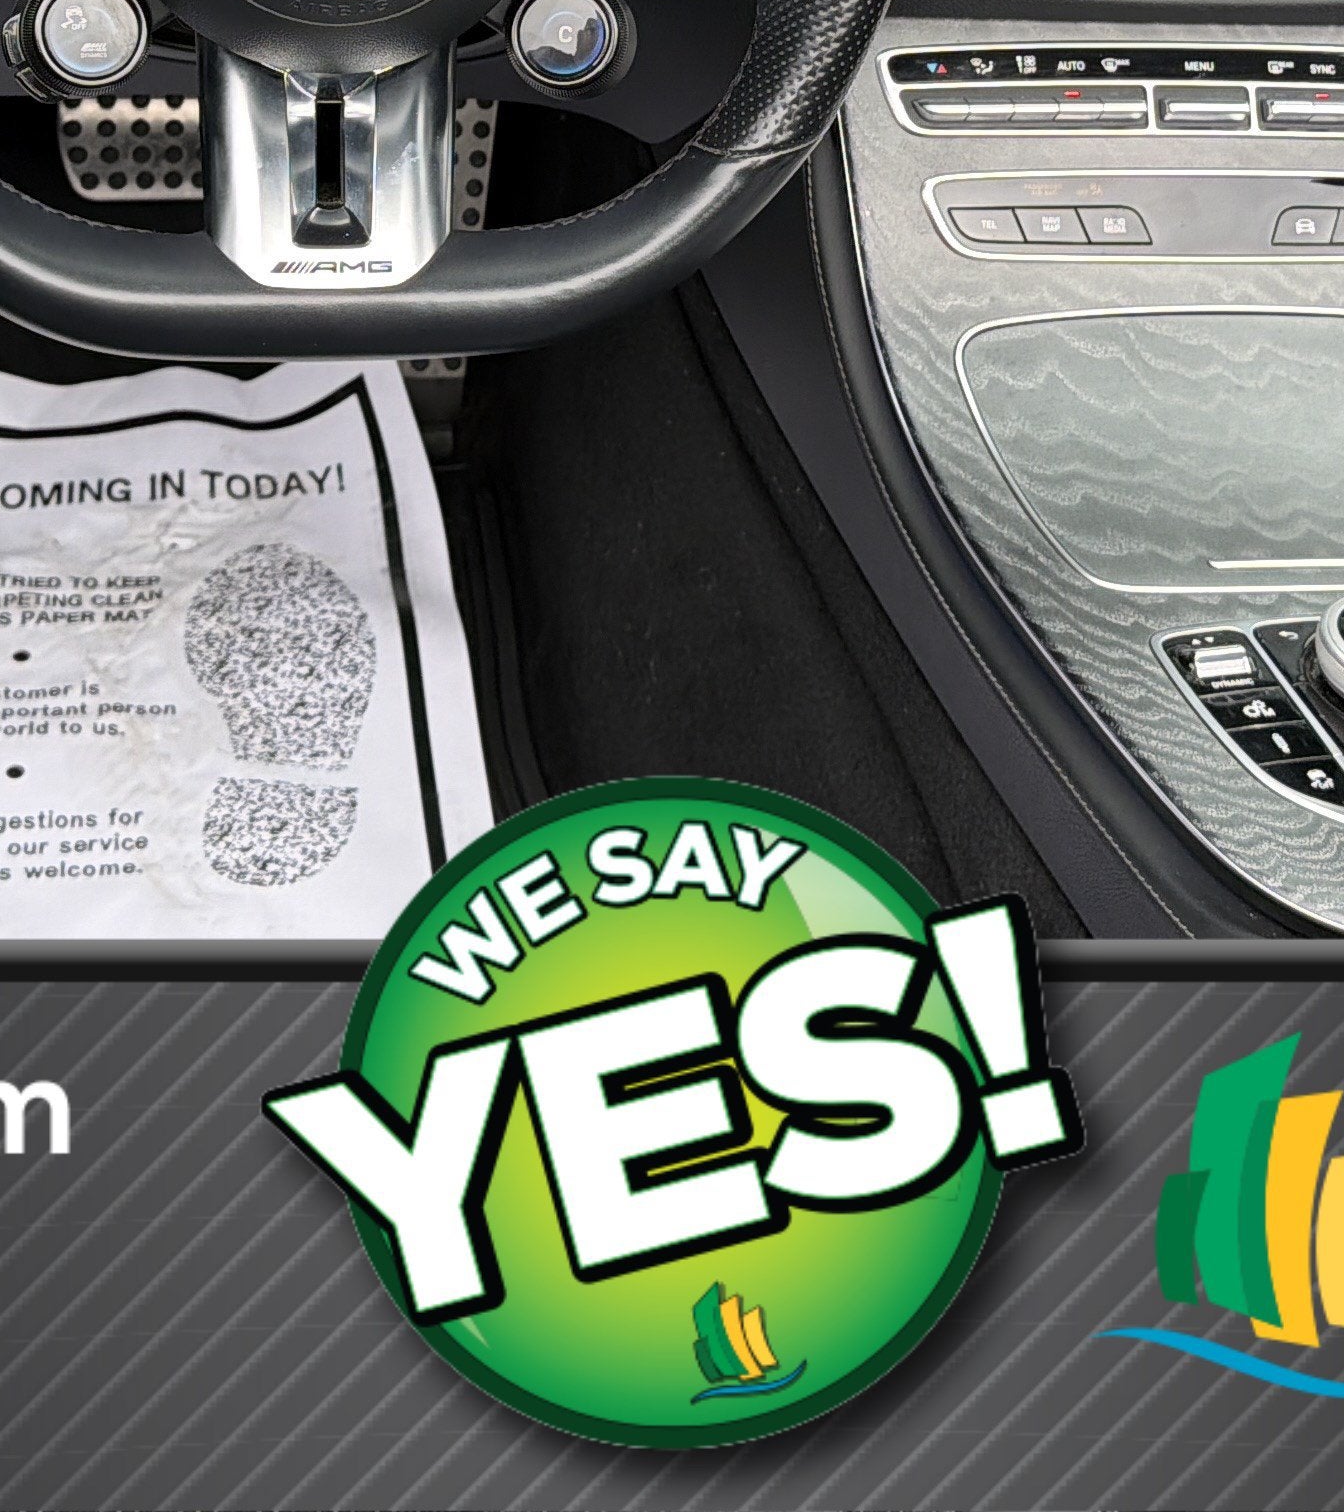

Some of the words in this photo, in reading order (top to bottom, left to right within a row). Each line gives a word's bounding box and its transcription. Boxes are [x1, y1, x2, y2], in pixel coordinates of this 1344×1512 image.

[557, 25, 574, 43] C
[1057, 60, 1086, 73] AUTO
[1184, 60, 1215, 72] MENU
[1309, 64, 1336, 76] SYNC
[981, 219, 997, 230] TEL
[149, 471, 187, 500] IN
[205, 463, 346, 502] TODAY!
[70, 575, 99, 590] TO
[106, 574, 161, 590] KEEP
[90, 589, 163, 606] CLEAN
[20, 610, 97, 626] PAPER
[104, 608, 154, 624] MAT
[81, 680, 100, 696] is
[97, 701, 177, 720] person
[59, 720, 82, 736] to
[92, 720, 126, 737] us.
[108, 807, 144, 827] for
[7, 839, 49, 856] our
[59, 833, 149, 854] service
[23, 859, 144, 878] welcome.
